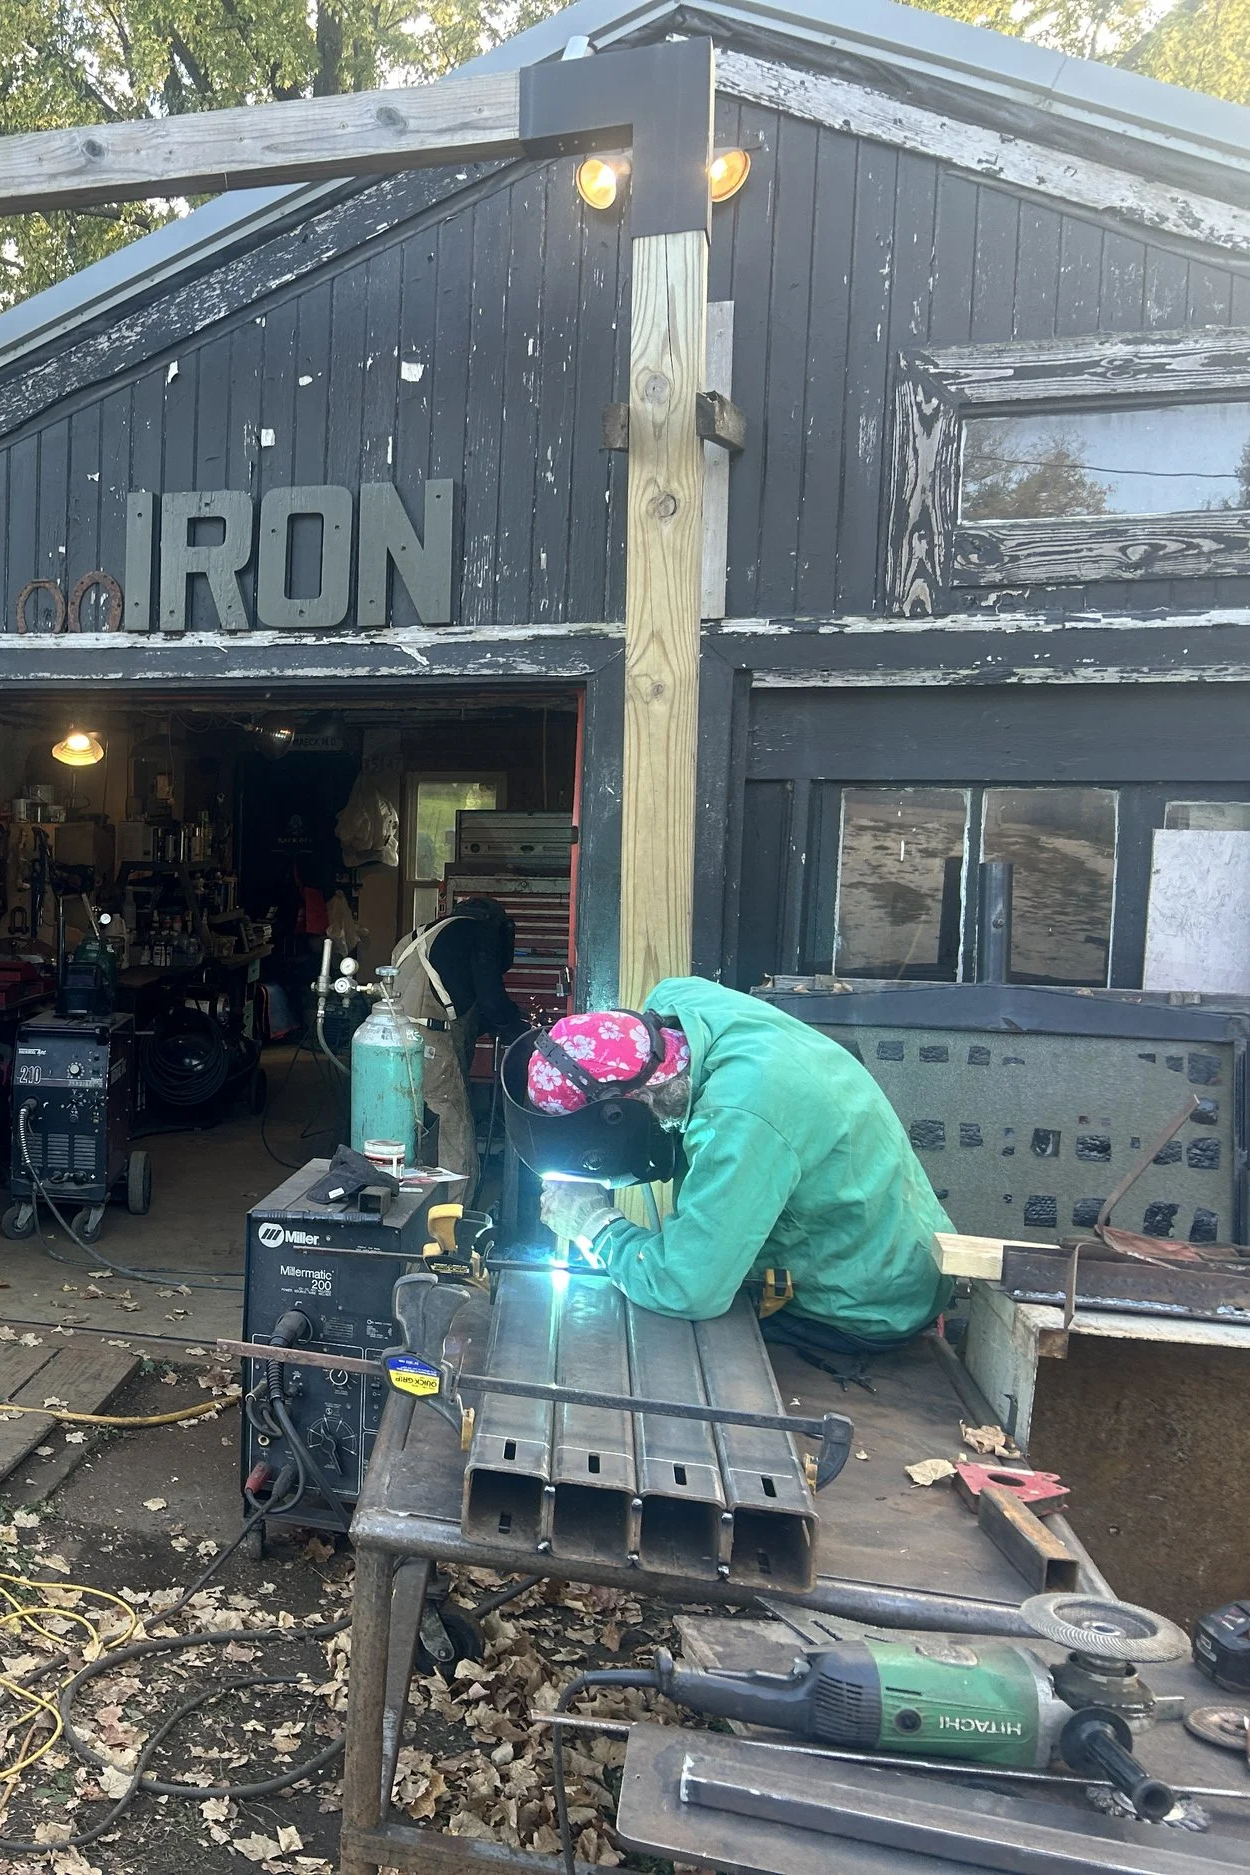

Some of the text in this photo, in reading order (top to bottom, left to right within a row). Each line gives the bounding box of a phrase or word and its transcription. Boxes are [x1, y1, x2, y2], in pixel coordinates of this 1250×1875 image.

[124, 478, 453, 632] IRON
[19, 1065, 42, 1085] 210
[285, 1230, 320, 1246] Miller
[280, 1265, 332, 1281] Millermatic
[311, 1280, 332, 1291] 200
[939, 1716, 1022, 1736] HITACHI
